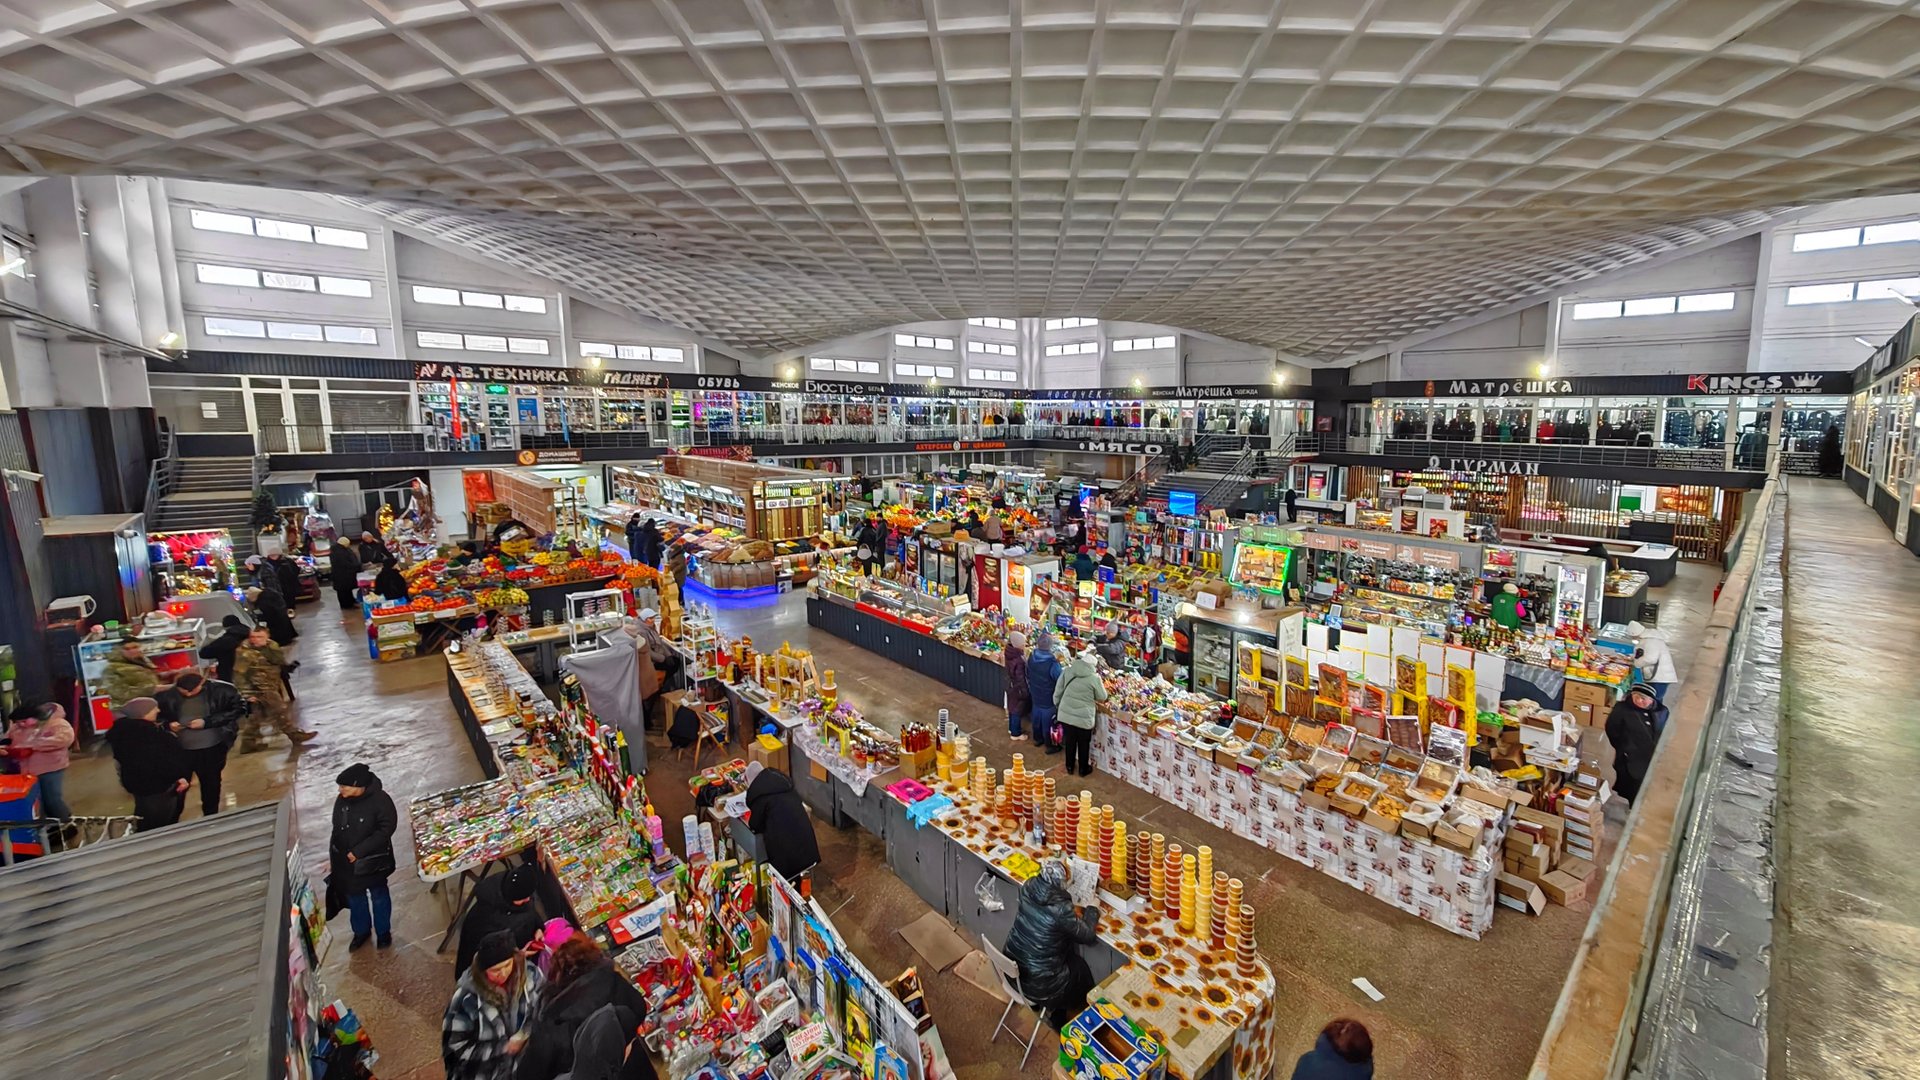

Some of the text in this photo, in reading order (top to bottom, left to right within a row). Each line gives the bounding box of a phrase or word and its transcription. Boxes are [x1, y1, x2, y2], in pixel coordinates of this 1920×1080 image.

[603, 372, 662, 387] ГАДЖЕТ
[698, 377, 740, 388] ОБУВЬ
[1687, 374, 1783, 393] KINGS
[771, 382, 799, 390] ЖЕНСКОЕ
[805, 380, 864, 394] Бюстье
[948, 387, 980, 397] Женский
[1449, 379, 1573, 396] Матрёшка
[1089, 442, 1163, 455] МЯСО
[1450, 458, 1541, 475] ГУРМАН
